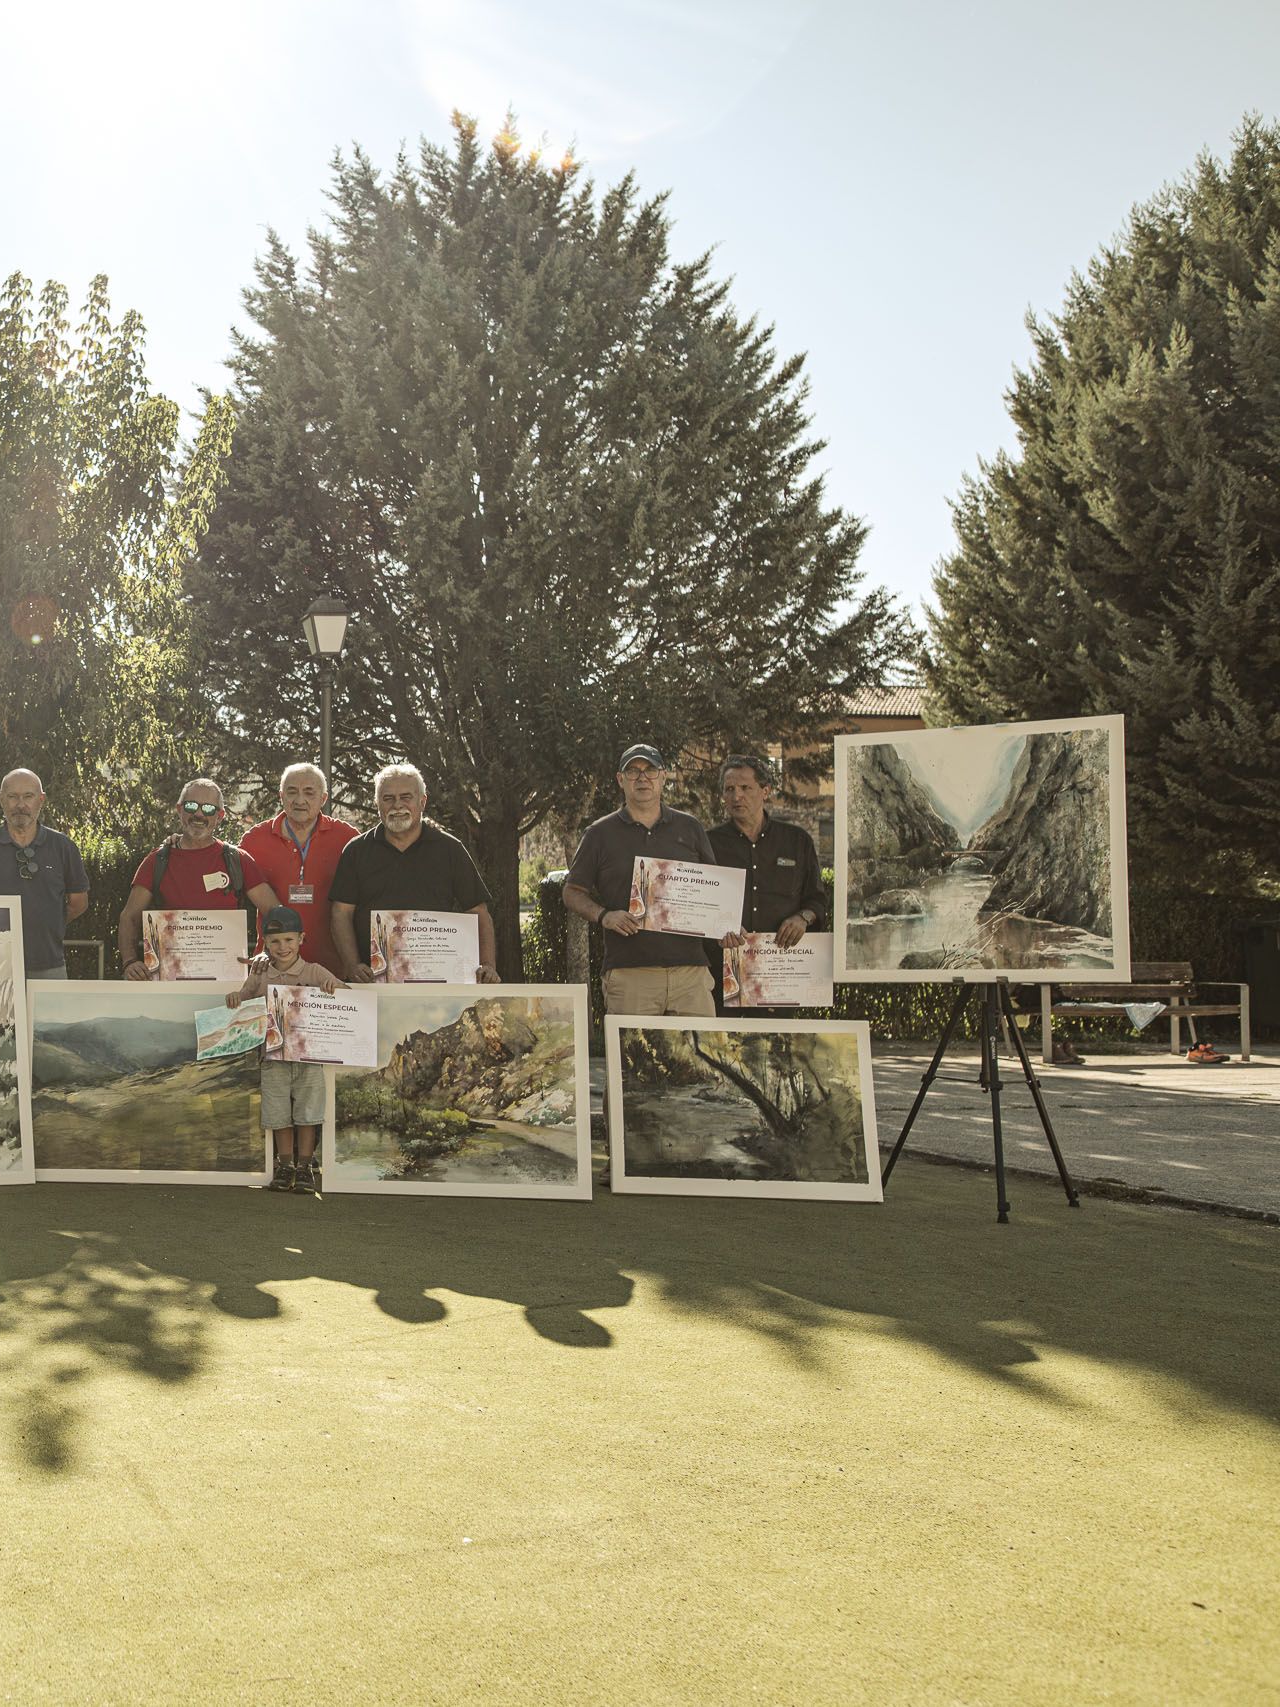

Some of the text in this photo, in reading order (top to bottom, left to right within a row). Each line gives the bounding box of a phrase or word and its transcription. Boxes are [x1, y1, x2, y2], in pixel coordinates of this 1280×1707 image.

[659, 874, 720, 887] CUARTO PREMIO
[743, 947, 777, 955] MENCIÓN
[287, 1001, 358, 1012] MENCIÓN ESPECIAL
